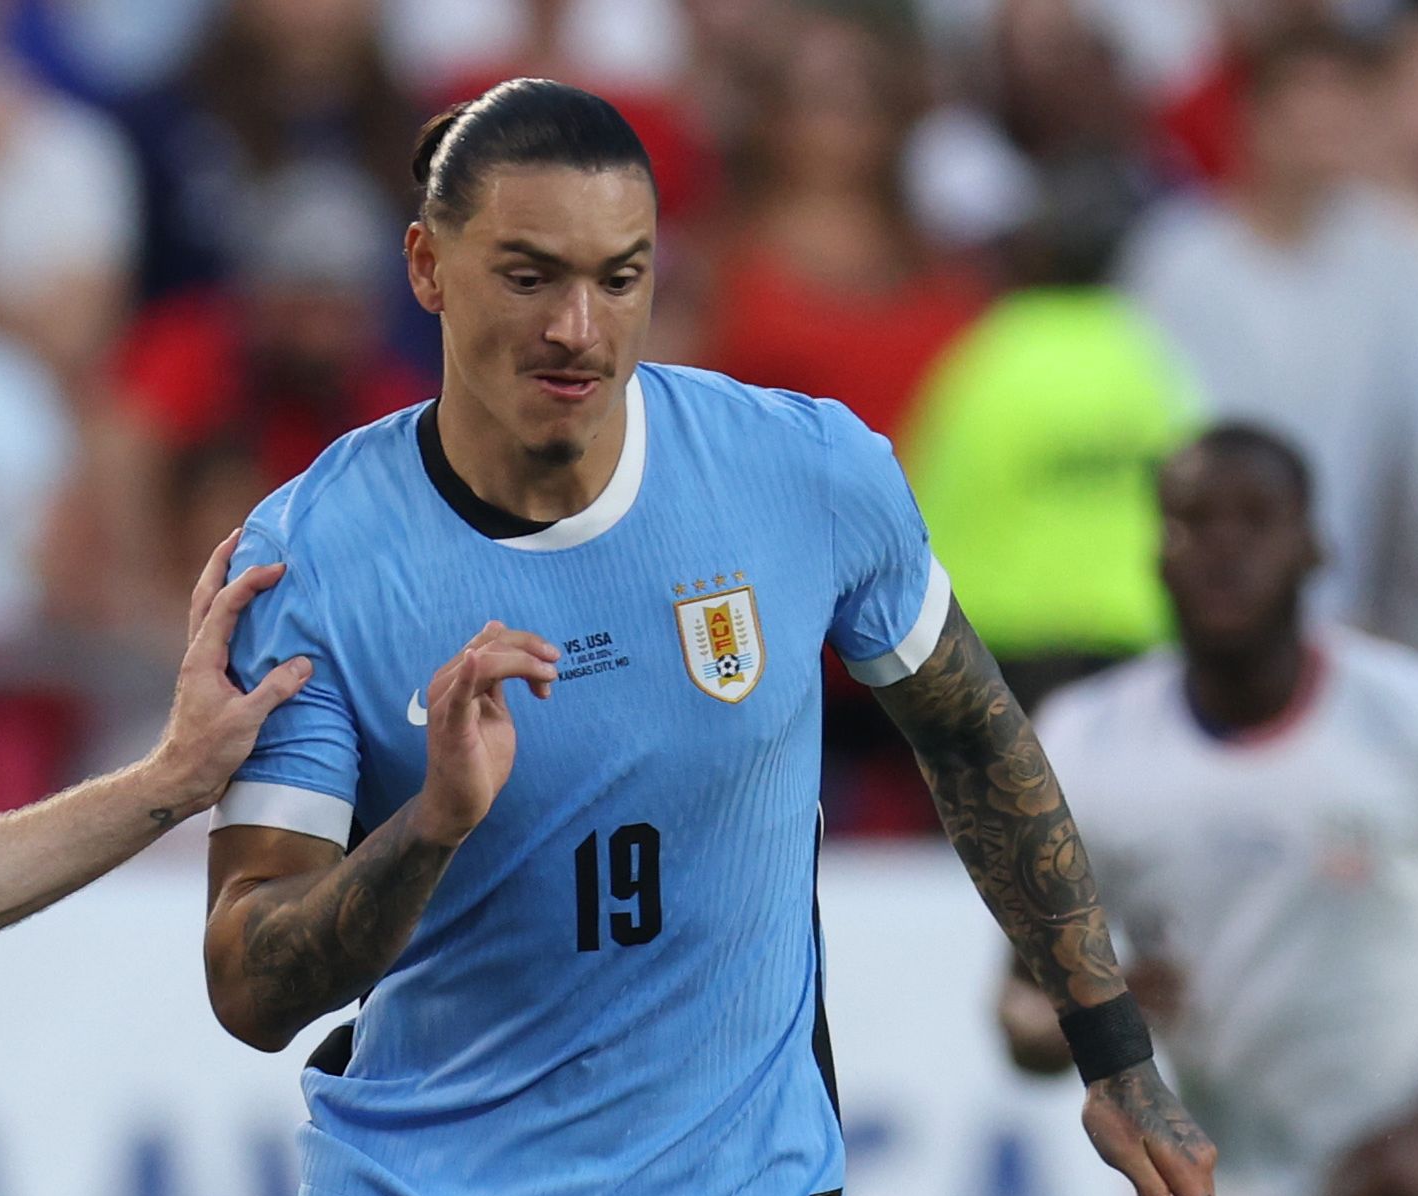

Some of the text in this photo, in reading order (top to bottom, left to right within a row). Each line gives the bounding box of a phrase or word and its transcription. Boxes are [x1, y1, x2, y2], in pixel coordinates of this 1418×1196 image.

[586, 632, 613, 648] USA
[711, 612, 732, 652] AUF
[558, 665, 593, 682] KANSAS
[615, 656, 630, 668] MO
[574, 822, 662, 953] 19
